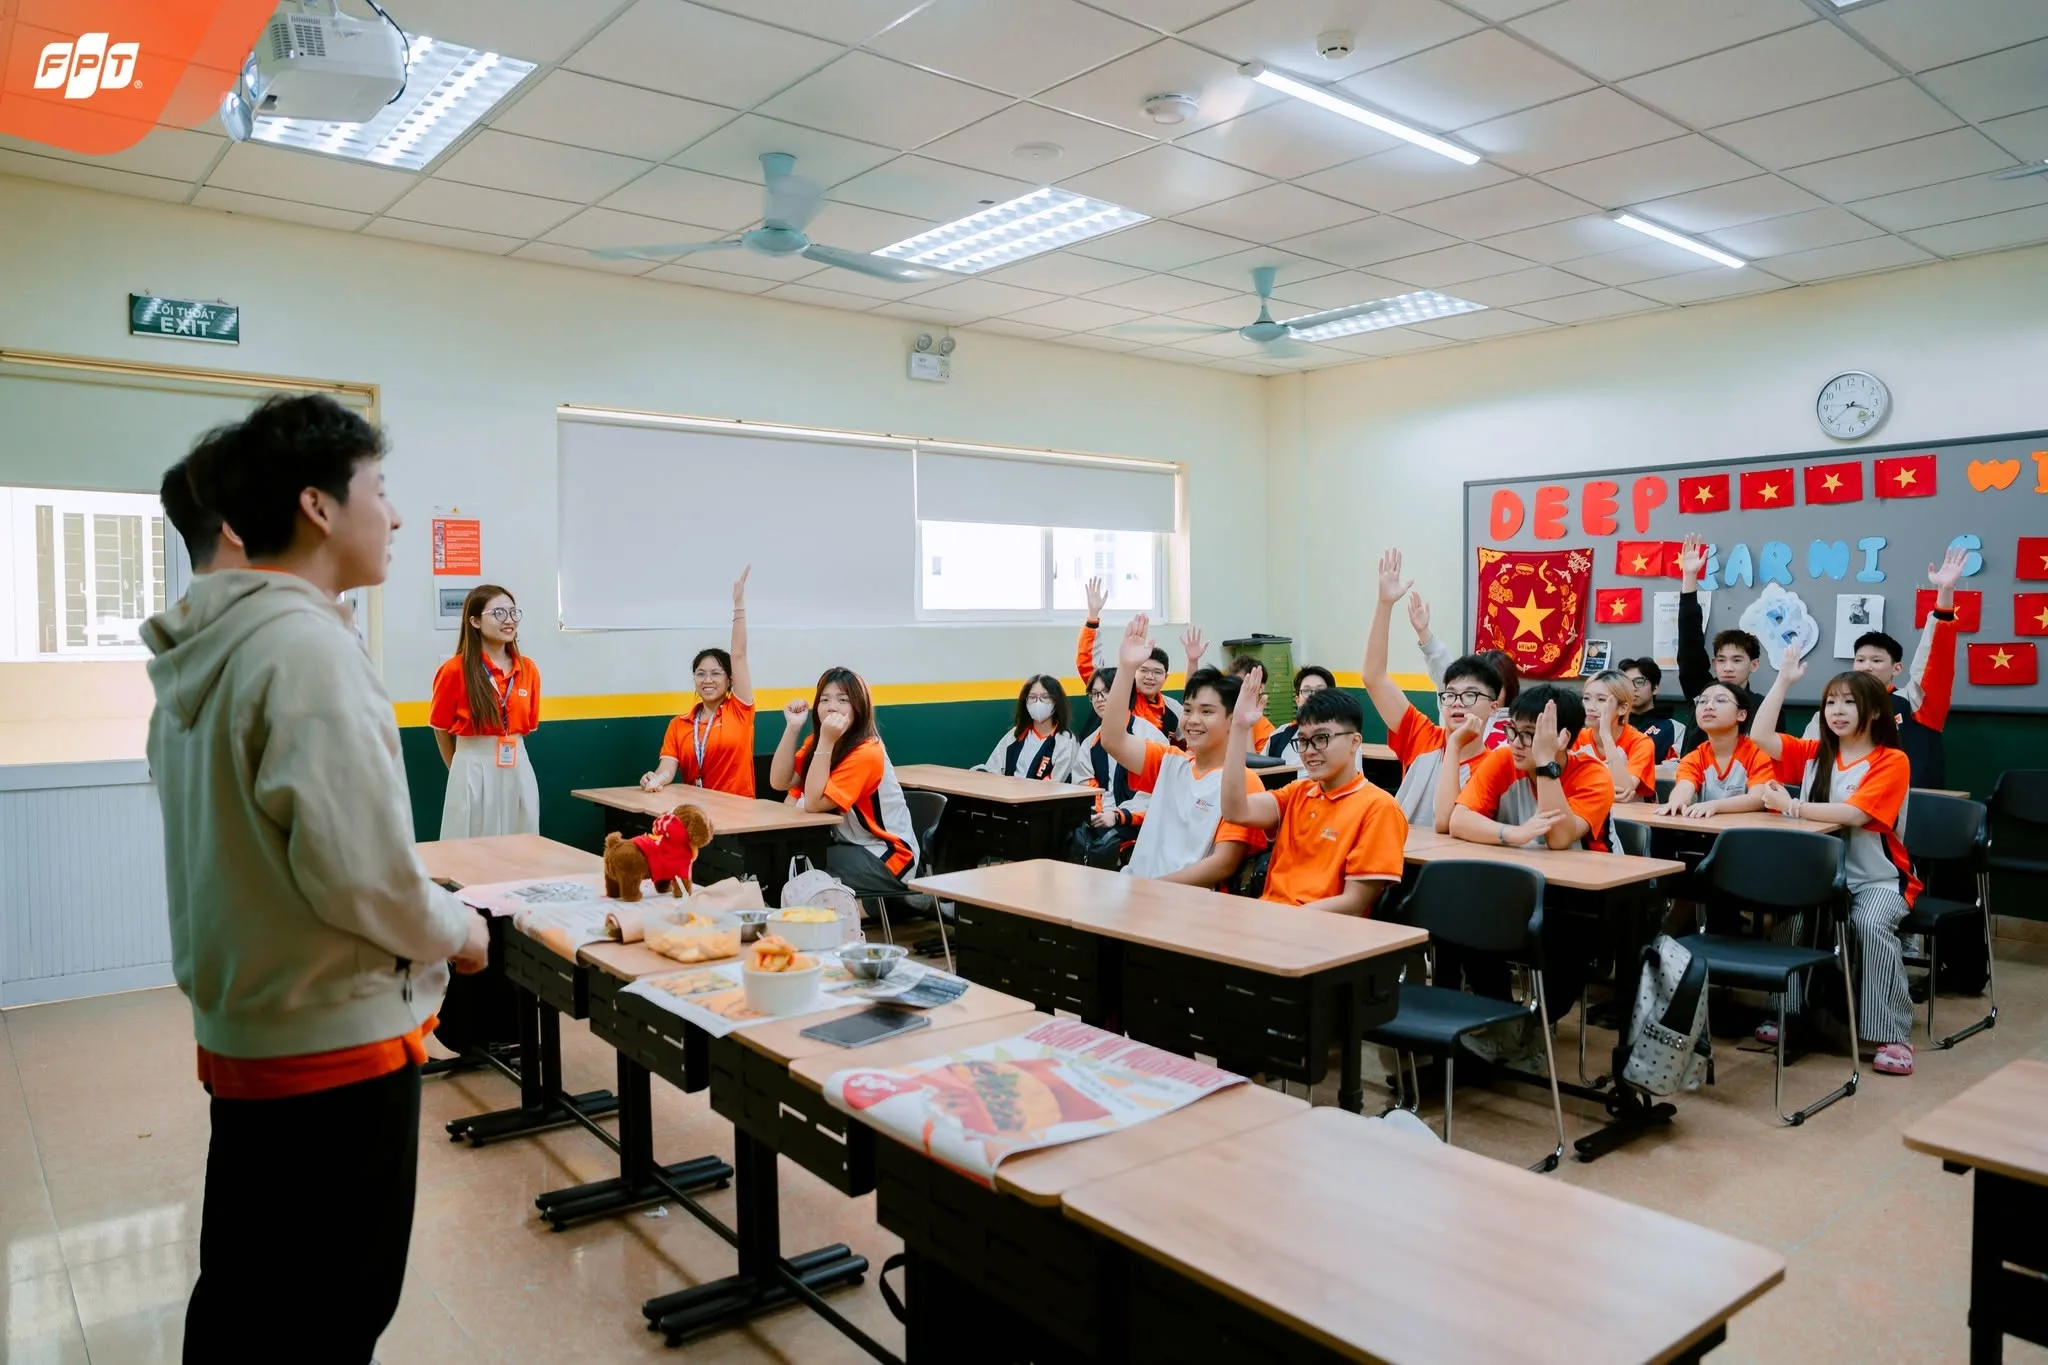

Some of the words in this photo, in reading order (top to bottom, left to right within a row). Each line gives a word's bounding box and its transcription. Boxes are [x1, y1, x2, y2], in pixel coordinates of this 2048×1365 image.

[154, 302, 174, 316] LỐI
[176, 307, 216, 320] THOÁT
[160, 316, 211, 336] EXIT
[1835, 382, 1841, 391] 11
[1847, 377, 1856, 387] 12
[1870, 387, 1875, 396] 2
[1824, 392, 1834, 401] 10
[1873, 398, 1879, 407] 3
[1823, 404, 1829, 412] 9
[1827, 415, 1833, 425] 8
[1836, 423, 1841, 432] 7
[1848, 425, 1855, 433] 6
[1489, 475, 1668, 541] DEEP
